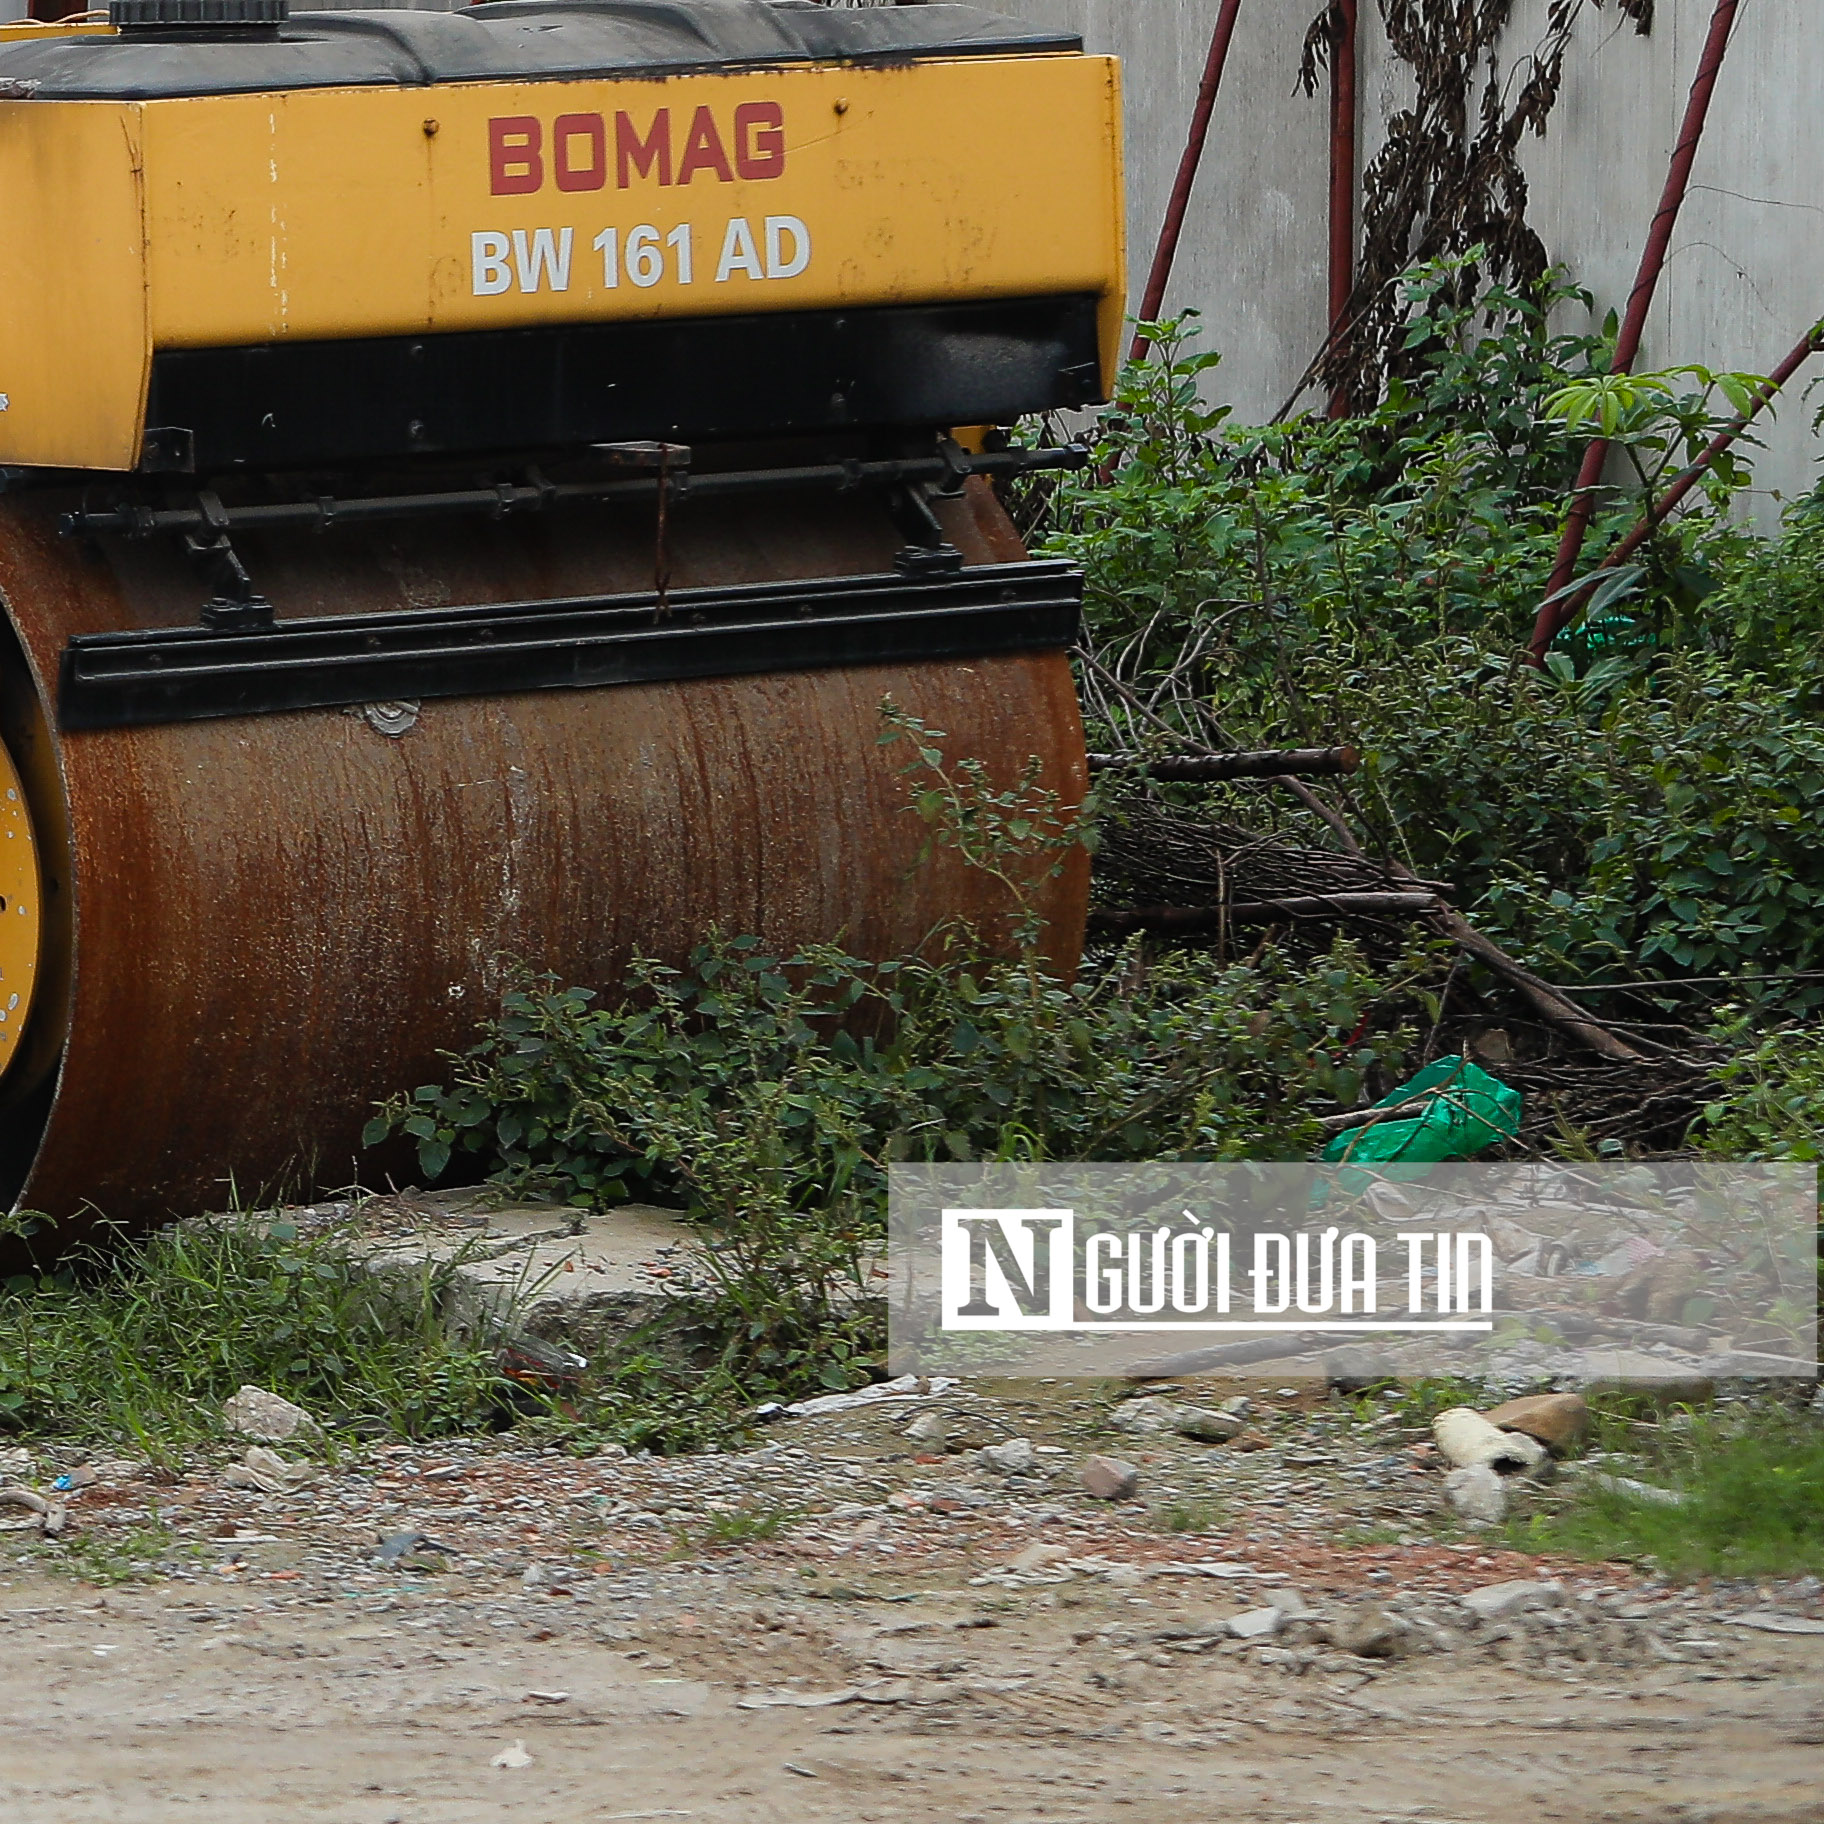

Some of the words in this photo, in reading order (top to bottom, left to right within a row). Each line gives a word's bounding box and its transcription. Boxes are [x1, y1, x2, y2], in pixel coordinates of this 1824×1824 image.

[488, 101, 785, 197] BOMAG
[470, 226, 574, 297] BW
[592, 223, 692, 289] 161
[715, 214, 811, 282] AD
